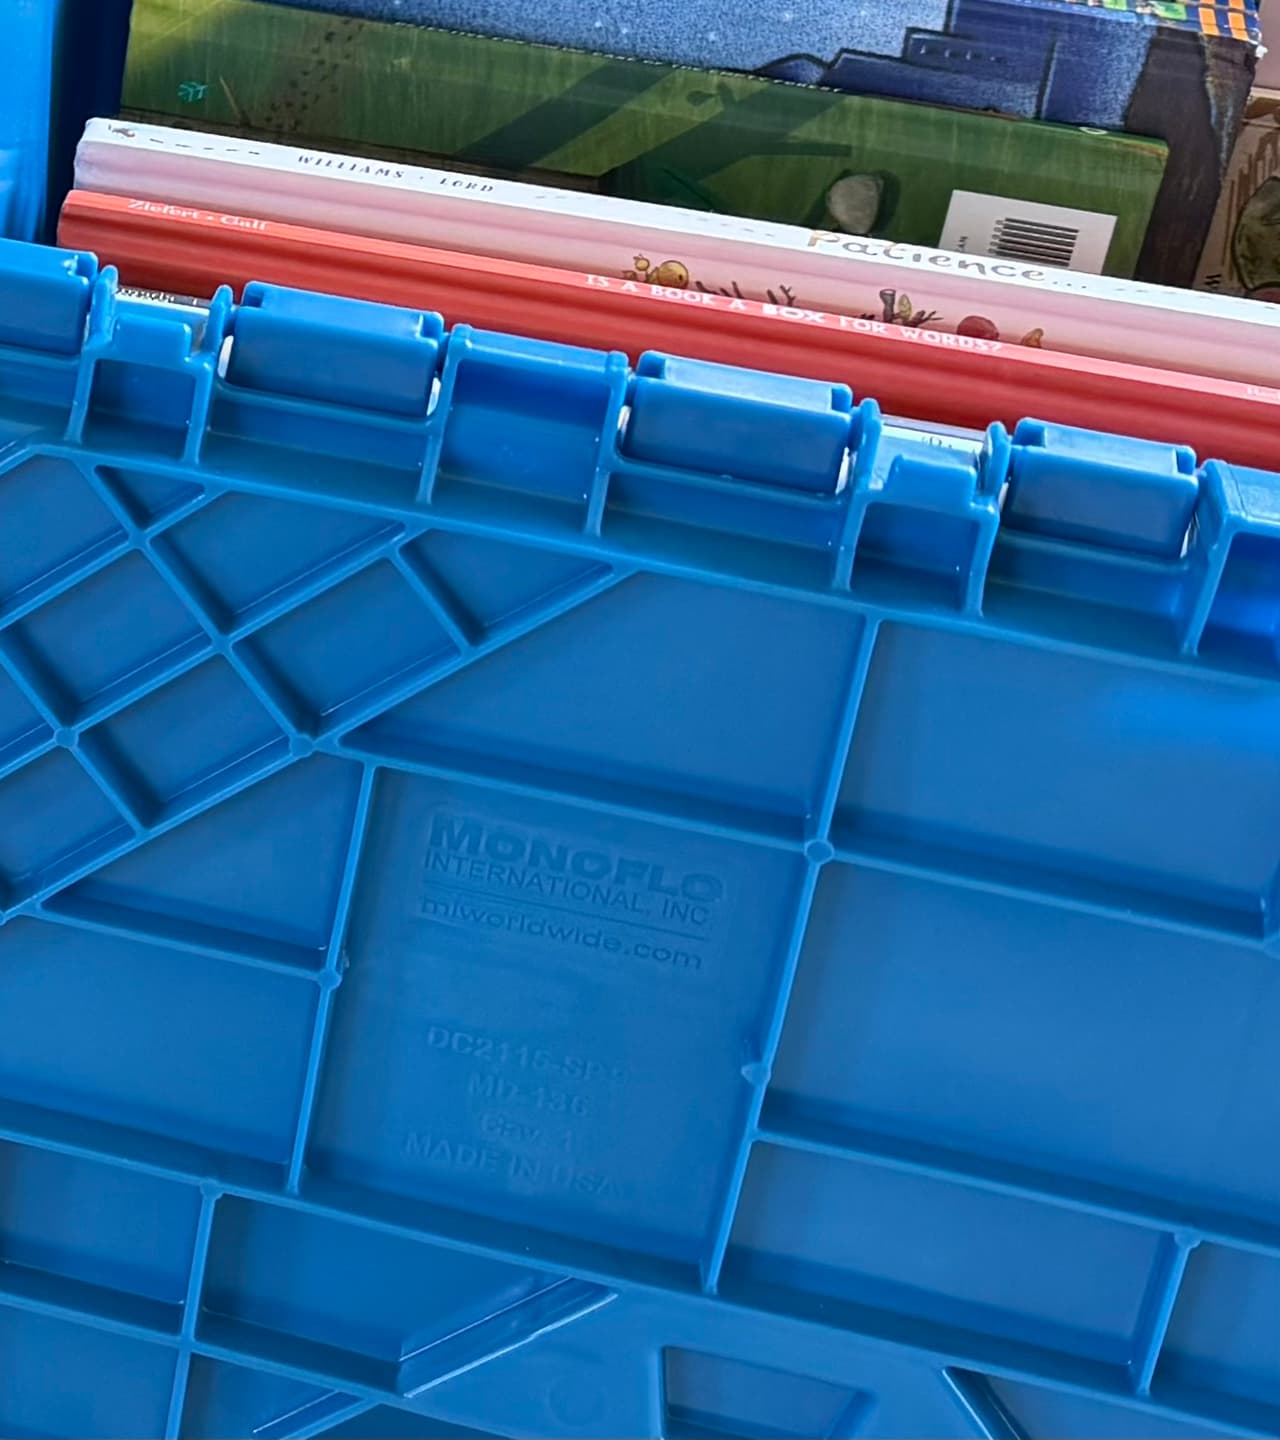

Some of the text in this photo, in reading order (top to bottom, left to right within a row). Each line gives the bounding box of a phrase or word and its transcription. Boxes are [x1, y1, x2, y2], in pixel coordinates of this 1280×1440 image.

[585, 274, 610, 288] IS
[618, 279, 641, 293] A
[650, 284, 716, 307] BOOK
[728, 296, 751, 311] A
[761, 301, 826, 325] BOX
[900, 324, 1003, 353] WORDS?
[428, 815, 724, 903] MONOFLO
[420, 896, 703, 970] miworldwide.com
[404, 1131, 625, 1200] MADE IN USA
